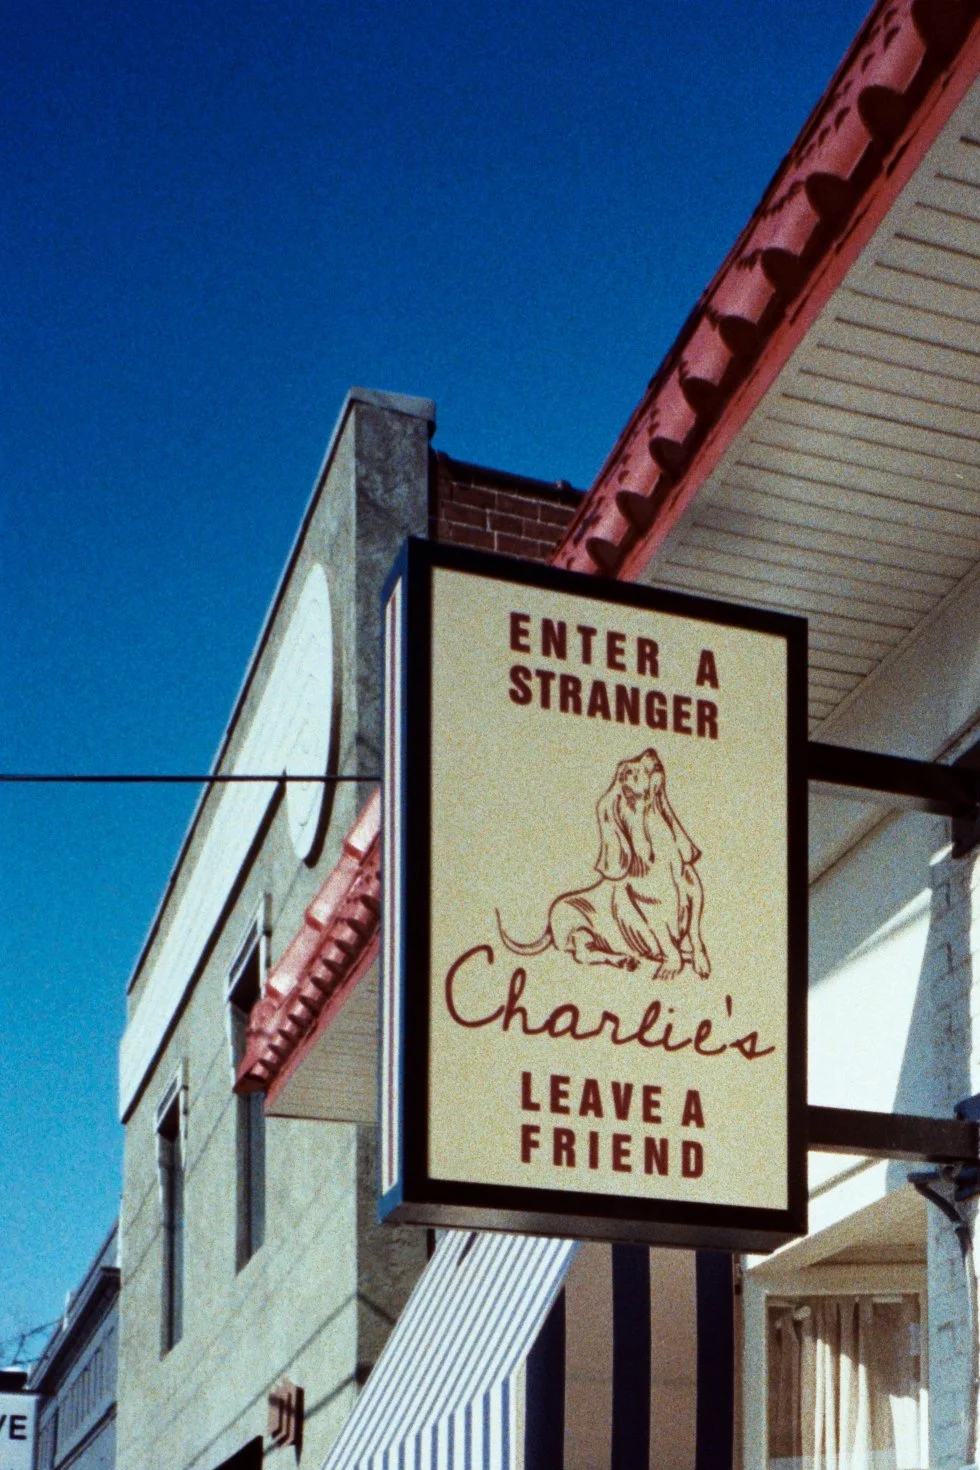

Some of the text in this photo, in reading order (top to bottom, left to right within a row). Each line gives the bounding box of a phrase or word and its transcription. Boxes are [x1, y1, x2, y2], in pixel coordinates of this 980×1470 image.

[508, 611, 720, 690] ENTER A
[508, 664, 720, 740] STRANGER
[444, 943, 776, 1060] Charlie's
[520, 1070, 706, 1129] LEAVE A
[520, 1124, 706, 1179] FRIEND
